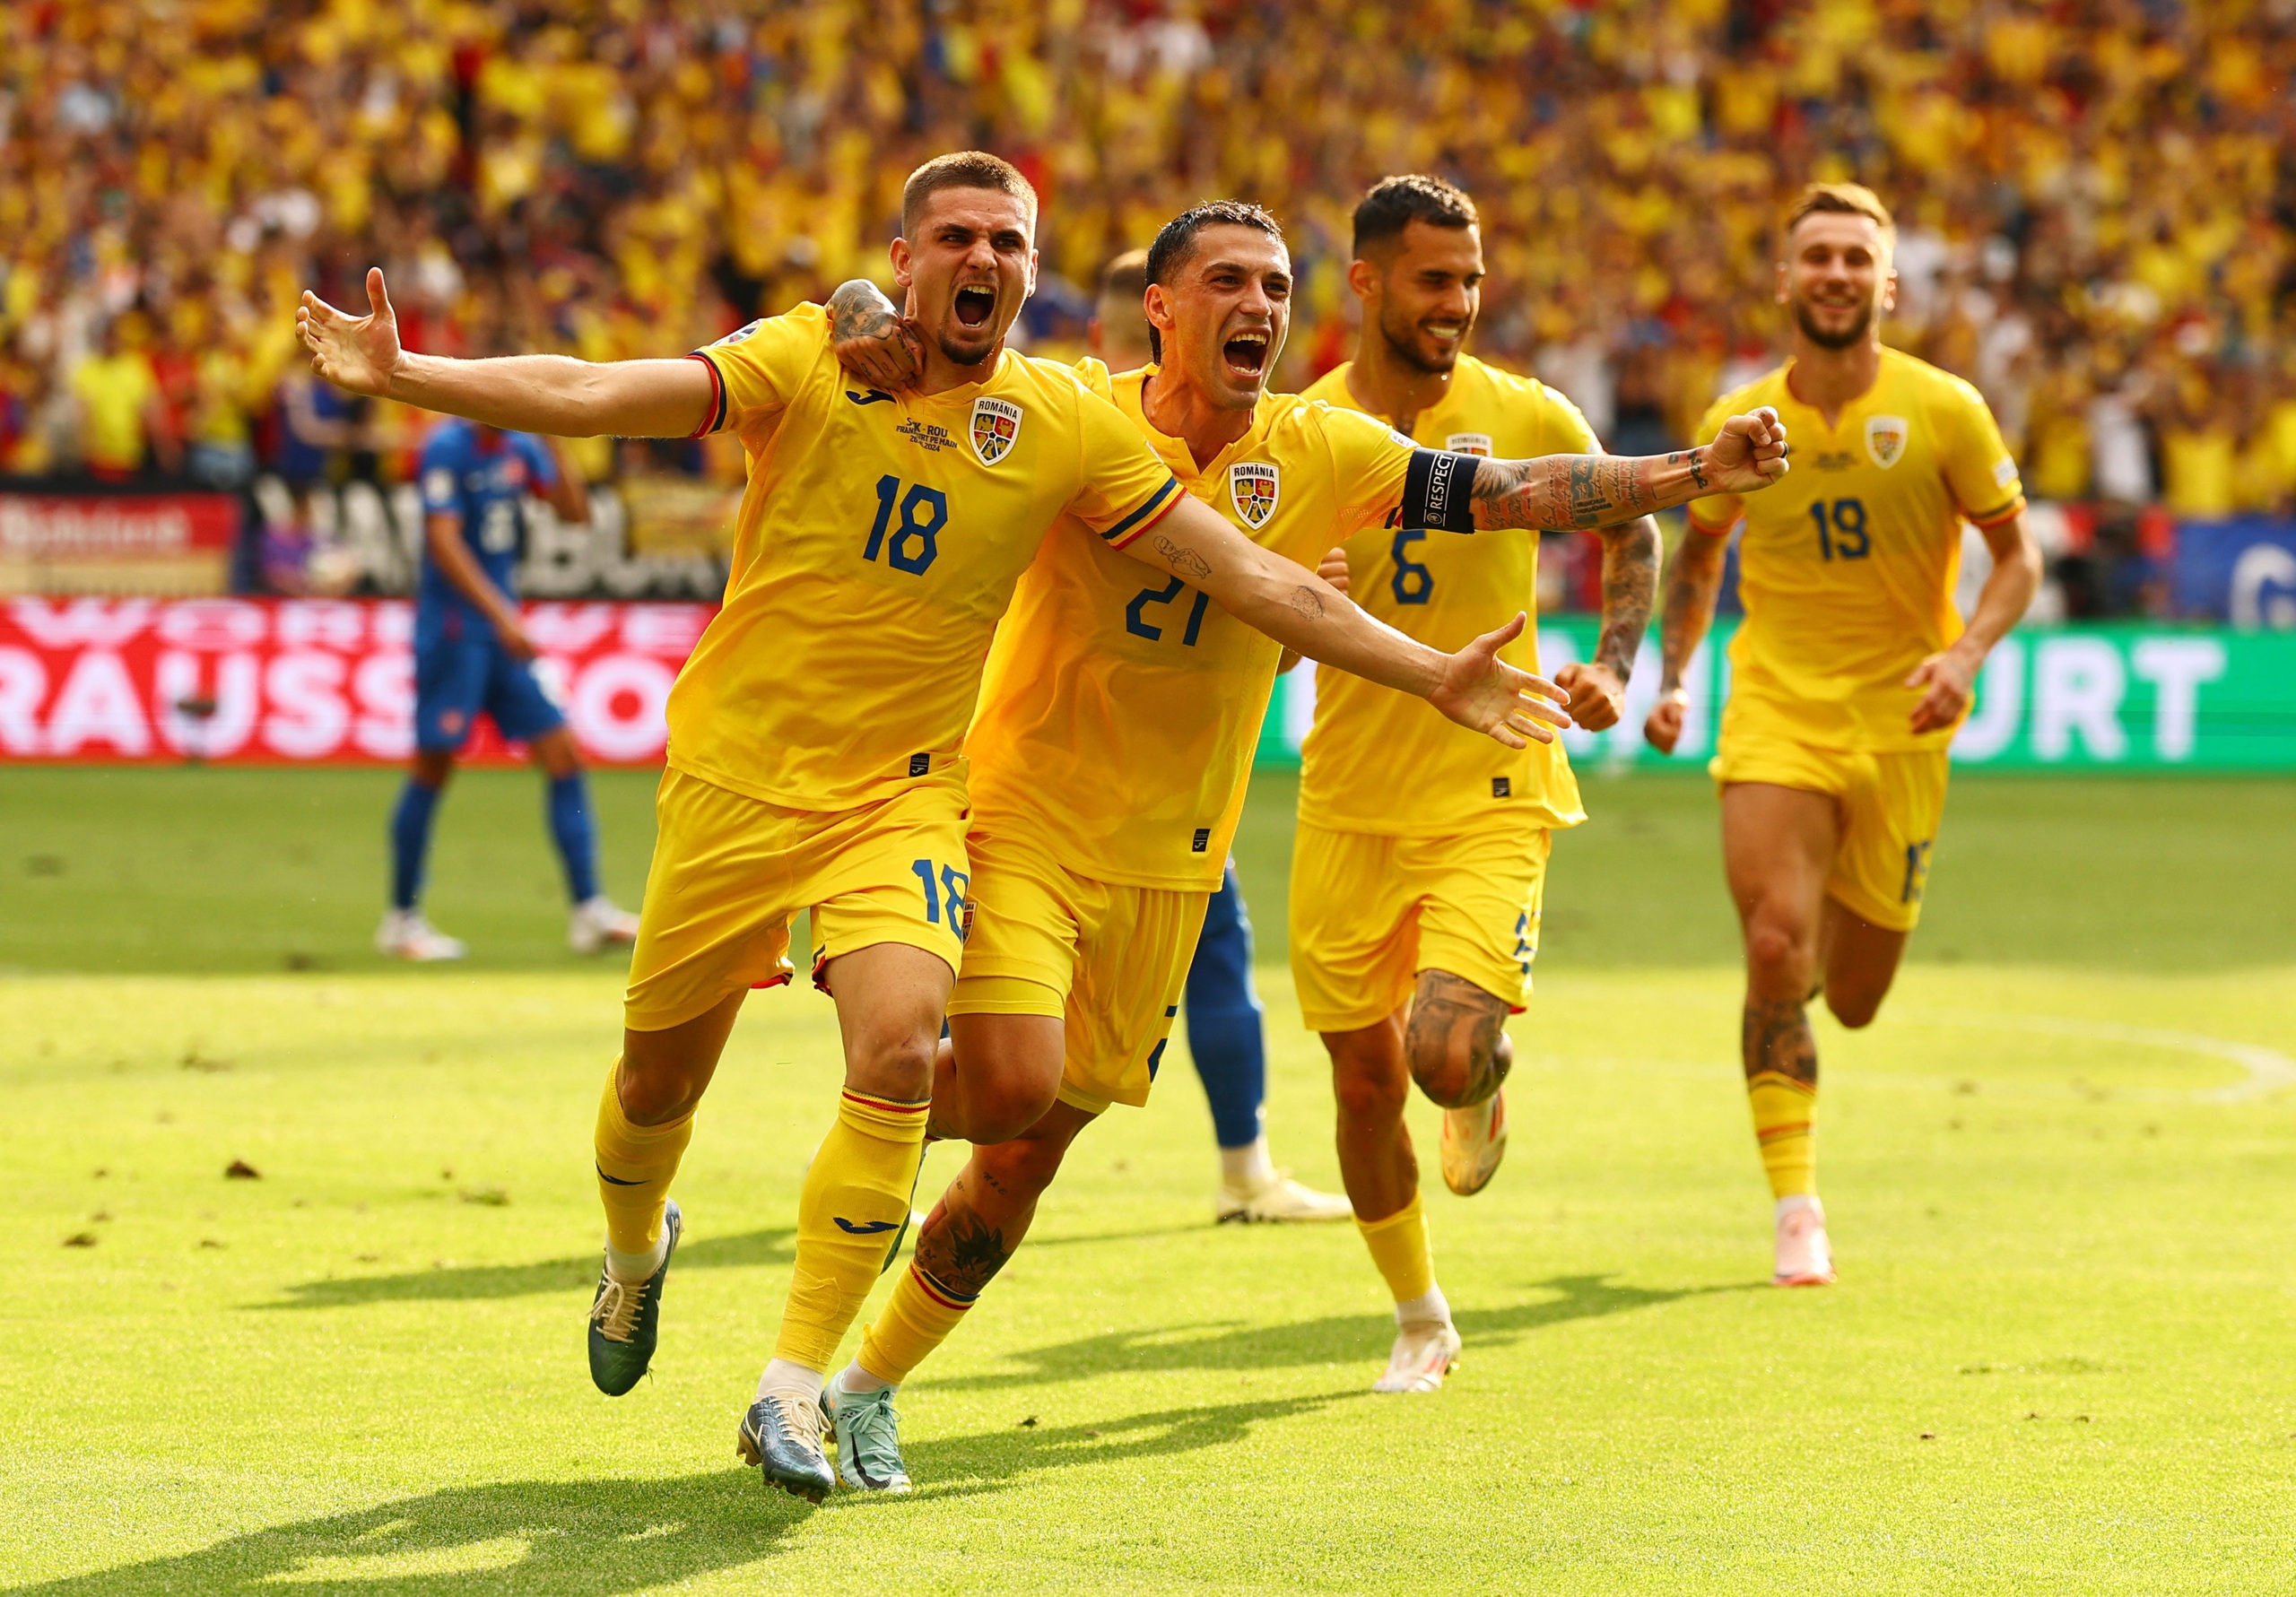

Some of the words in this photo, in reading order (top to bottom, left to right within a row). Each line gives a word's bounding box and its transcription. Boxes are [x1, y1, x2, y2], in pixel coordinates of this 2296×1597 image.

[907, 417, 921, 432] SK
[926, 424, 949, 438] ROU
[978, 400, 1018, 419] ROMÂNIA
[929, 436, 939, 444] PE
[939, 438, 958, 448] MAIN
[1234, 464, 1274, 478] ROMÂNIA
[1430, 454, 1453, 510] RESPECT
[863, 474, 948, 576] 18
[1811, 499, 1871, 561] 19
[1391, 530, 1434, 604] 6
[1126, 574, 1209, 647] 21
[911, 859, 970, 945] 18
